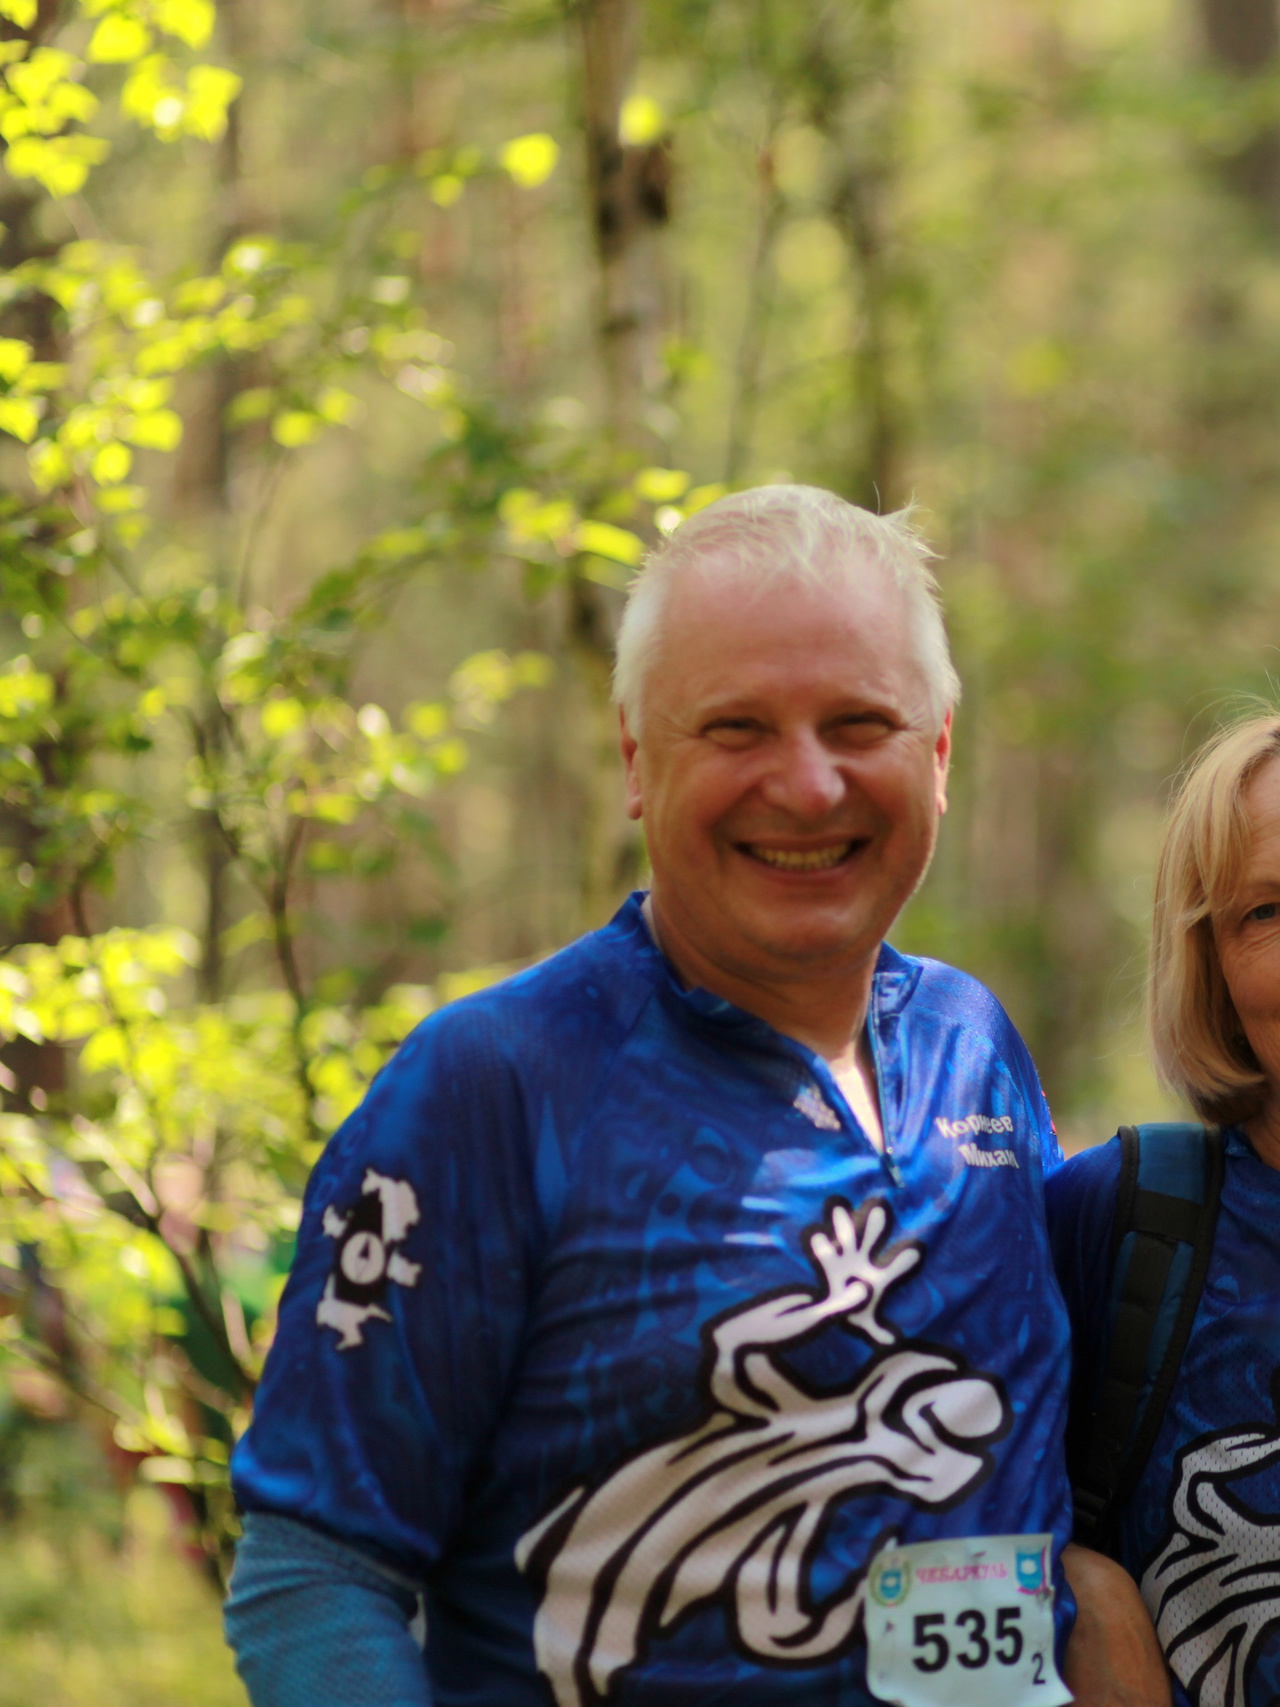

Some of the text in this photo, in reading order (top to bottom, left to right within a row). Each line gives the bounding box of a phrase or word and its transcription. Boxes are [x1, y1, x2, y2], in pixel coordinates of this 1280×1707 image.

[915, 1563, 1008, 1584] ЧЕБАРКУЛЬ
[912, 1606, 1047, 1686] 535 2
